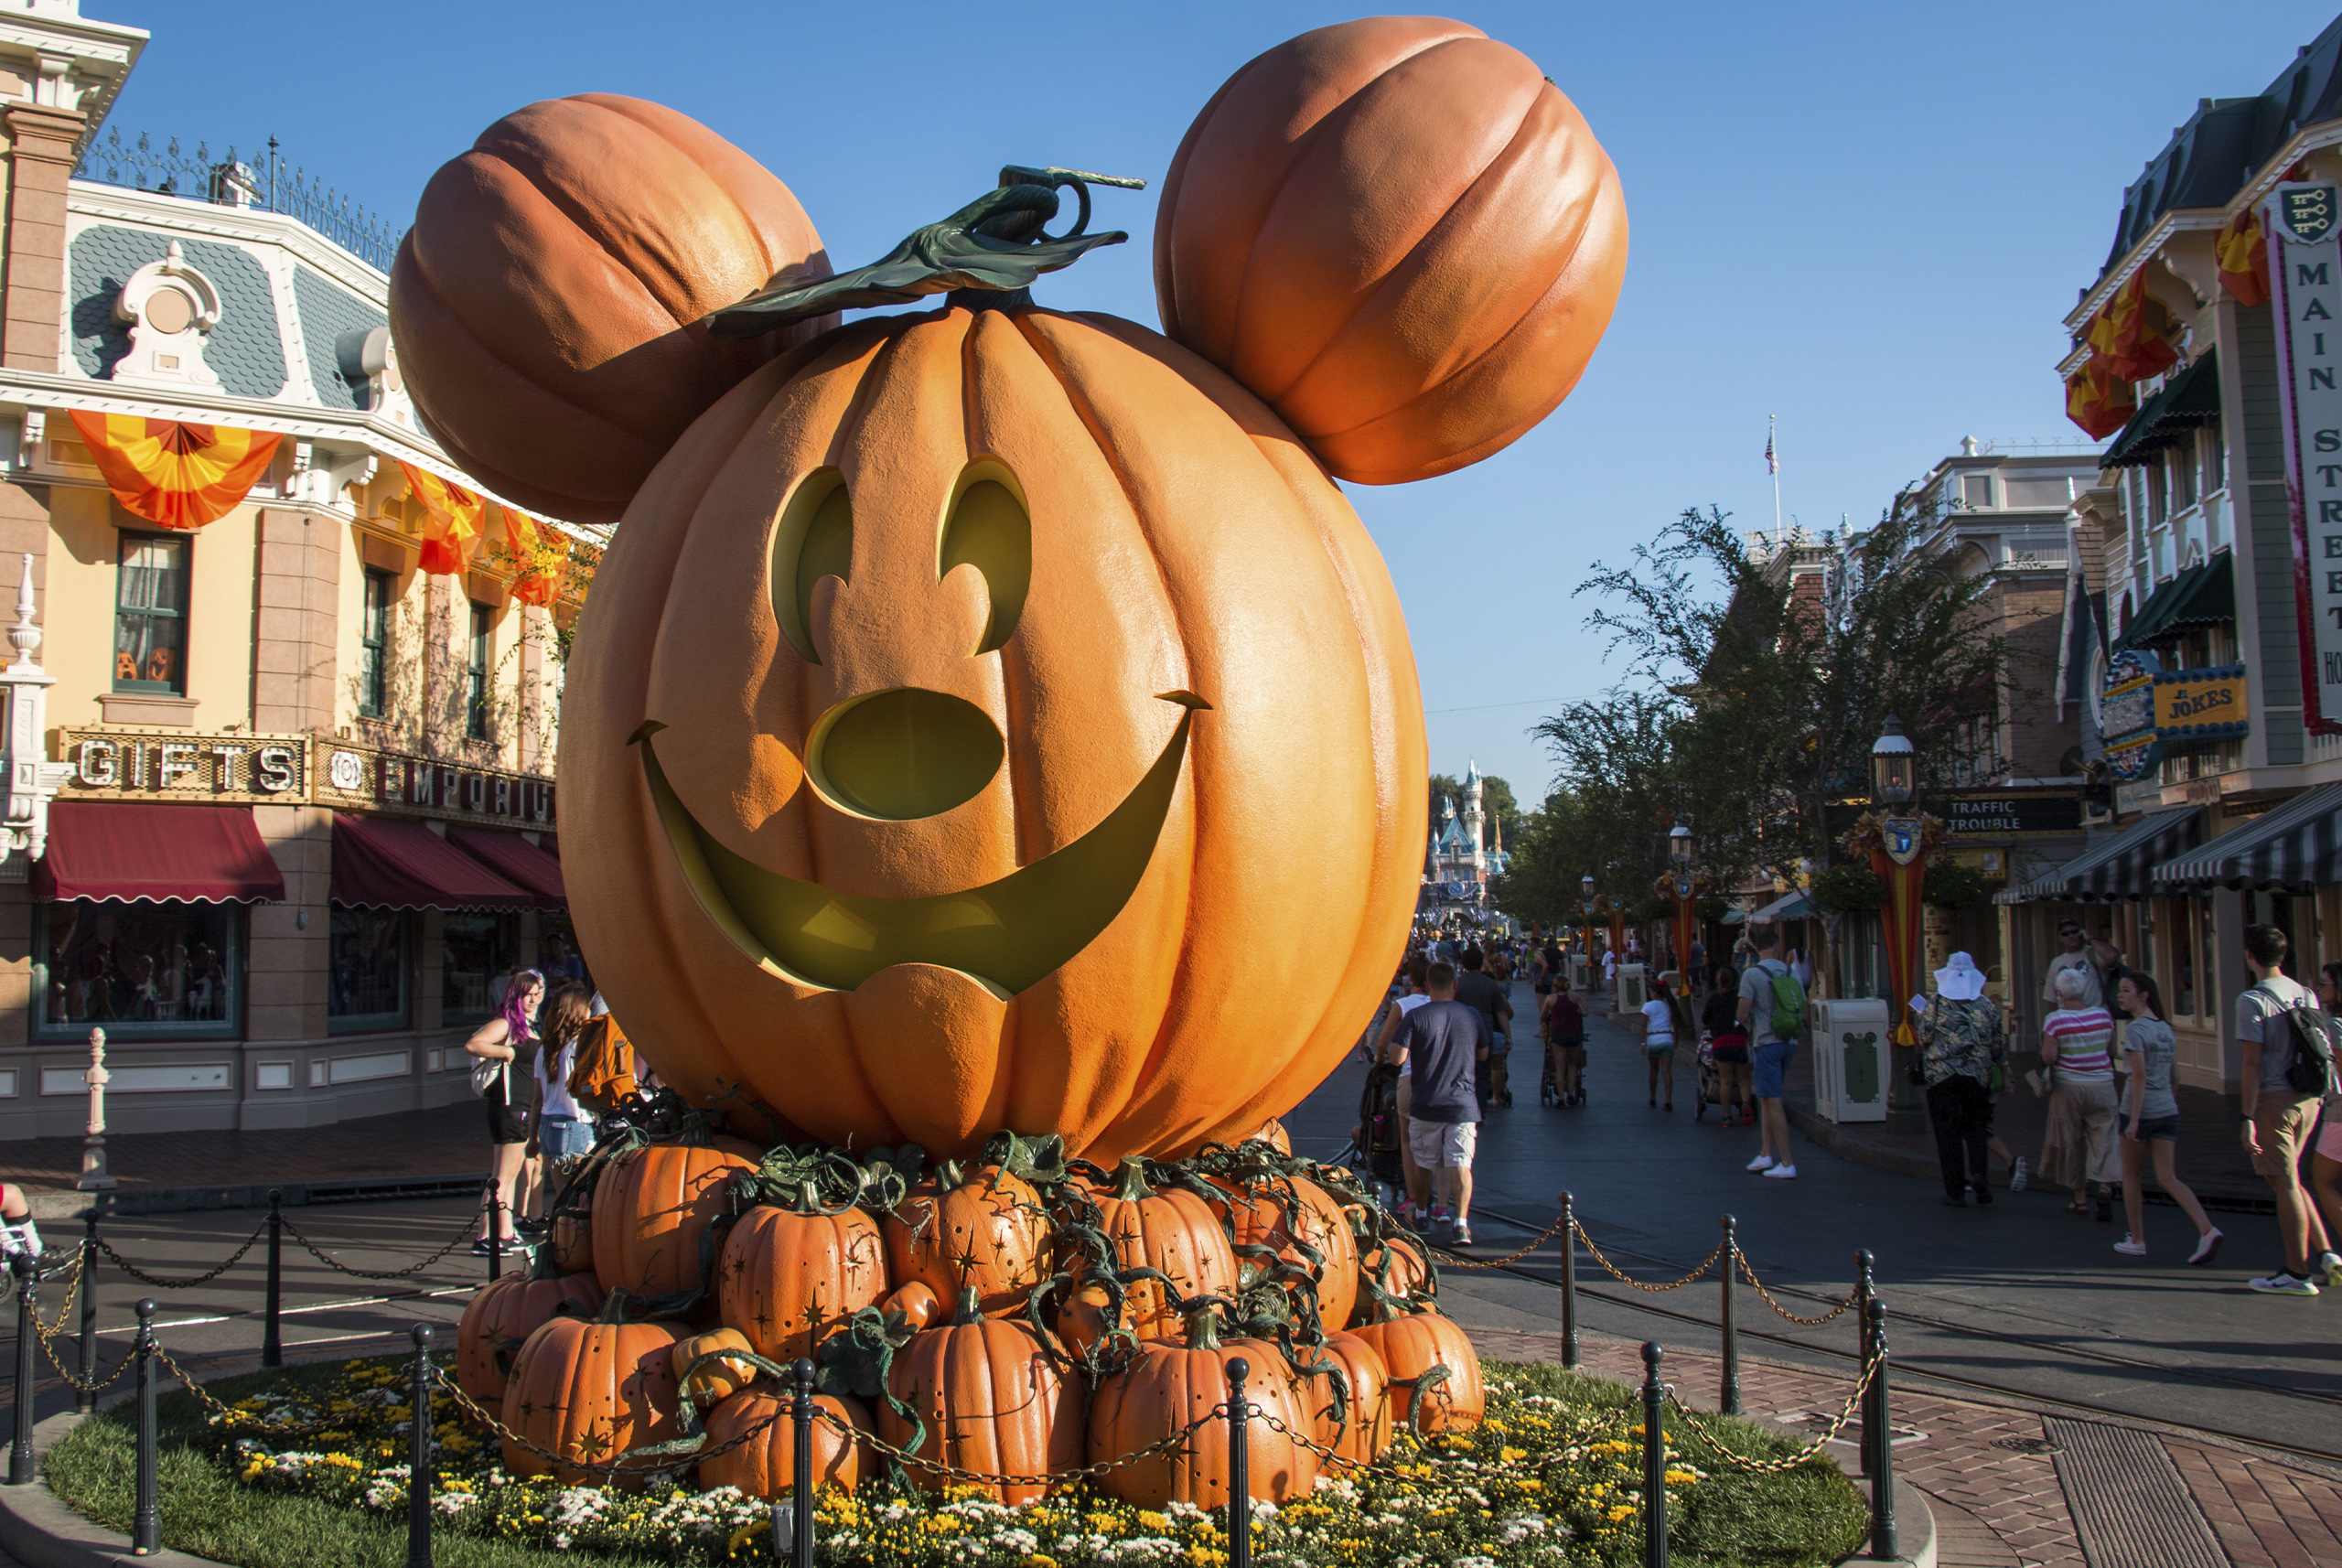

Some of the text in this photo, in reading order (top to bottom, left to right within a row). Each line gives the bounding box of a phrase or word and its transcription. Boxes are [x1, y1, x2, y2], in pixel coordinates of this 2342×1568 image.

[2296, 263, 2337, 391] MAIN
[2169, 688, 2232, 719] JOKES
[79, 738, 296, 791] GIFTS
[375, 756, 556, 826] EMPORIU
[1950, 800, 2015, 813] TRAFFIC
[1948, 818, 2022, 831] TROUBLE
